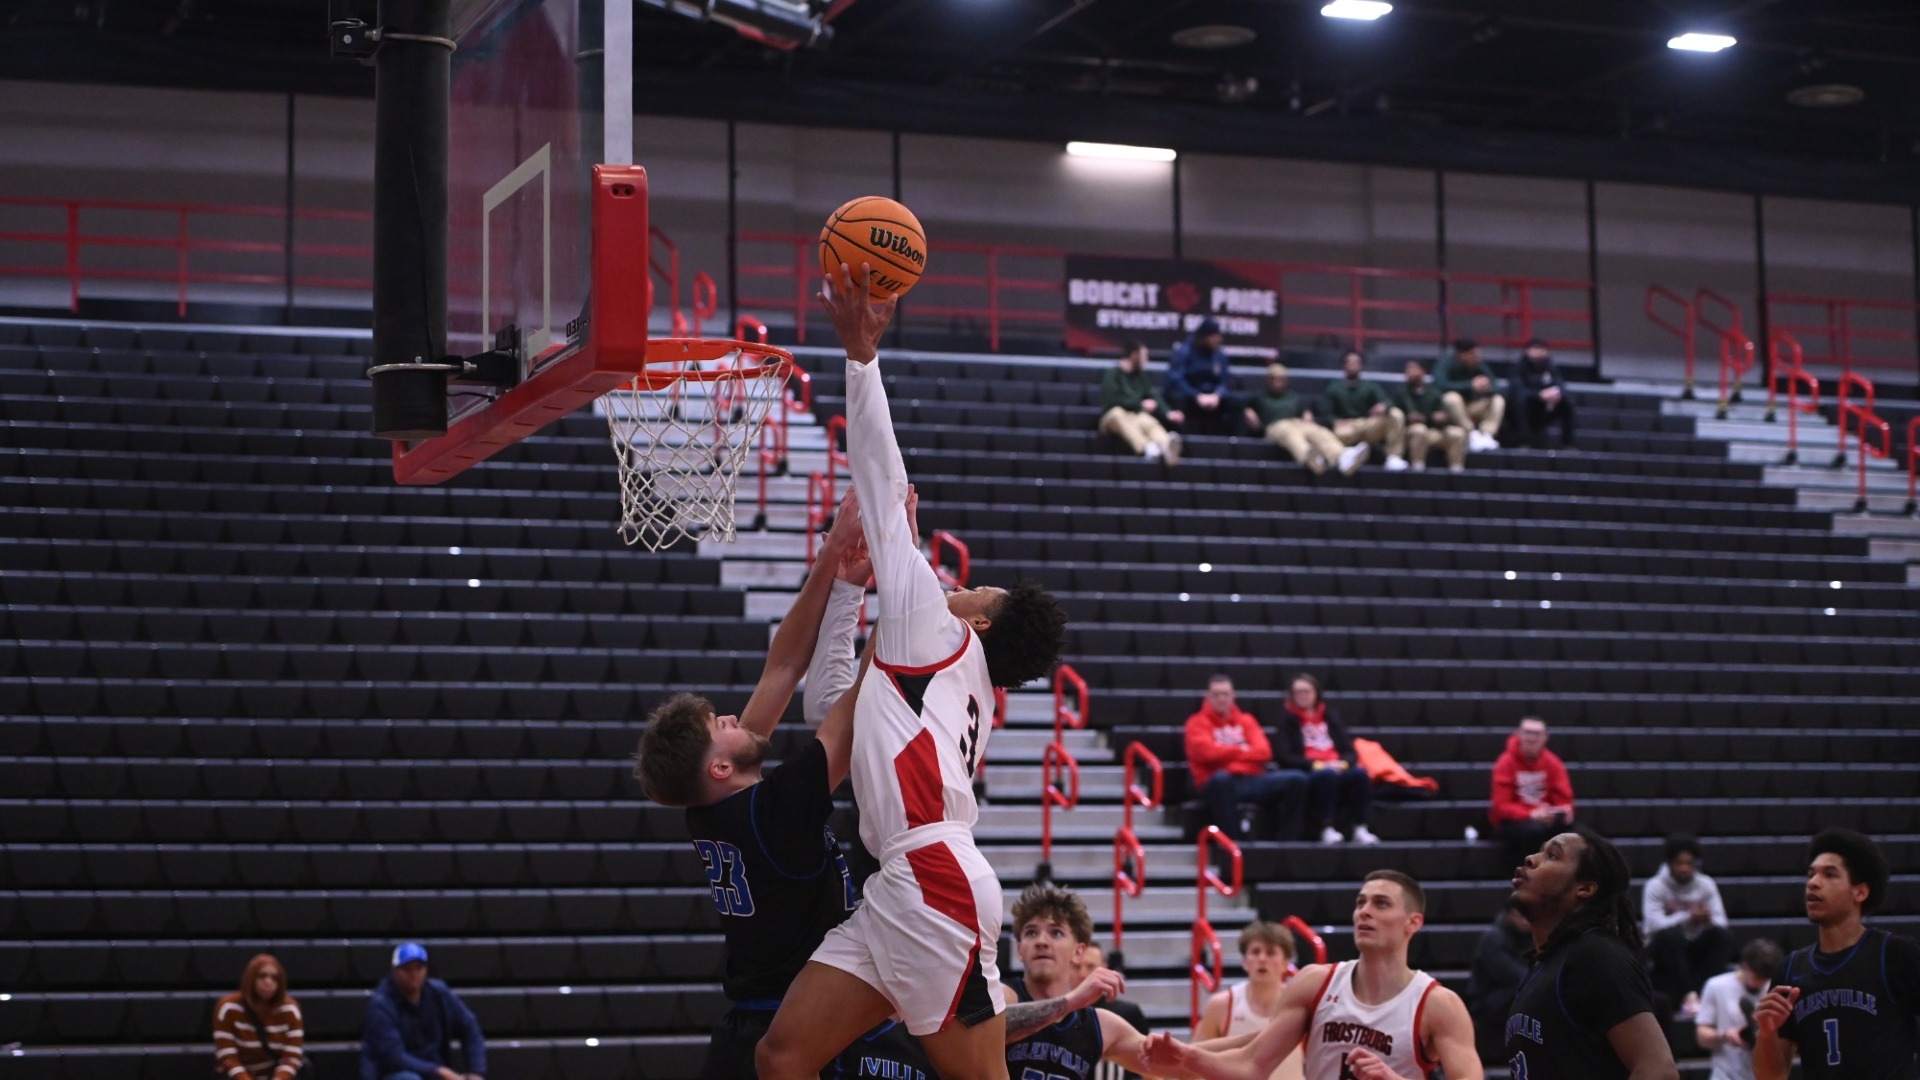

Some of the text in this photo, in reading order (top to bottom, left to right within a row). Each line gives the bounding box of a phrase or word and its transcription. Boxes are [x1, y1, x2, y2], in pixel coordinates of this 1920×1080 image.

[870, 226, 925, 268] Wilson
[1069, 279, 1277, 316] BOBCAT PRIDE
[1097, 309, 1180, 330] STUDENT
[959, 693, 980, 778] 3
[693, 839, 756, 917] 23
[1794, 988, 1878, 1024] LENVILLE
[1322, 1021, 1393, 1056] FROSTBURG
[1823, 1018, 1841, 1066] 1
